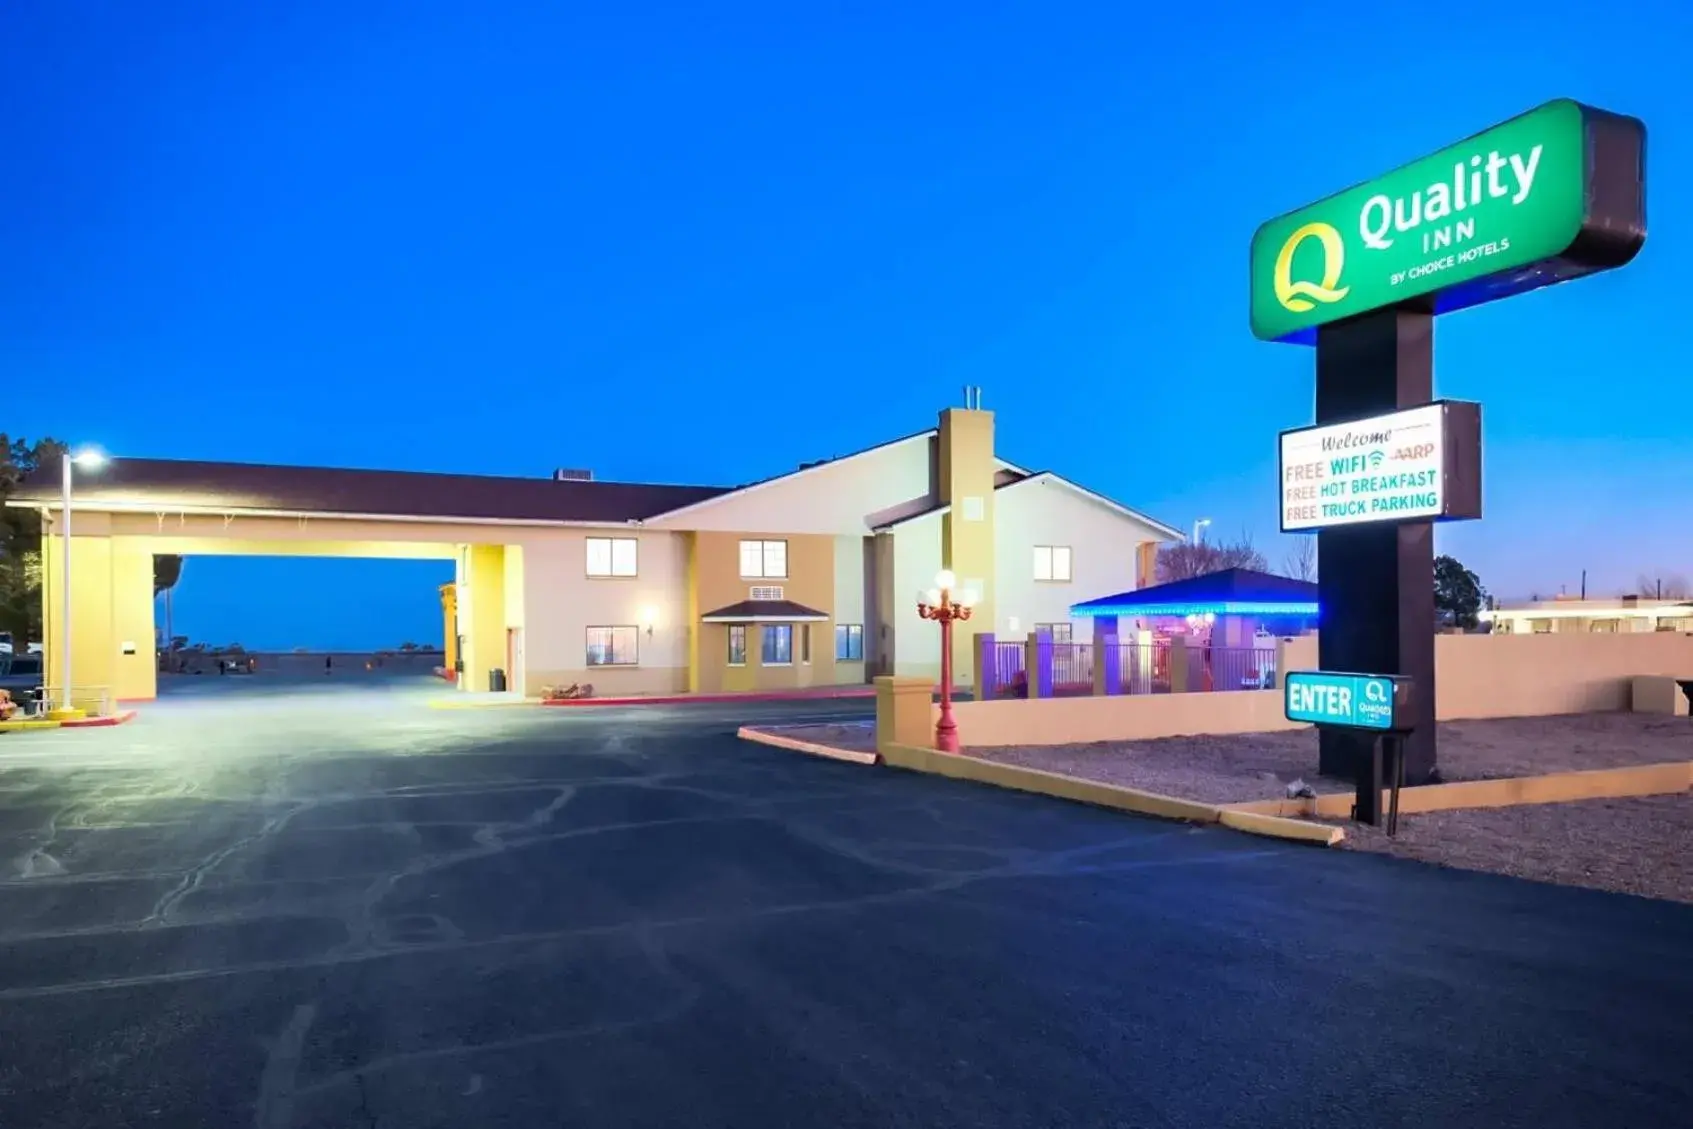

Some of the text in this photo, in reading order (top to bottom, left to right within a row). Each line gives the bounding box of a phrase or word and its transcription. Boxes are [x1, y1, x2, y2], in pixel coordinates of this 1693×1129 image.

[1359, 145, 1543, 249] Quality
[1423, 218, 1475, 253] INN
[1391, 238, 1510, 286] BY CHOICE HOTELS
[1322, 429, 1392, 452] Welcome
[1389, 443, 1435, 461] AARP
[1286, 455, 1366, 482] FREE WIFI
[1286, 470, 1436, 501] FREE HOT BREAKFAST
[1286, 492, 1437, 522] FREE TRUCK PARKING
[1289, 683, 1352, 717] ENTER
